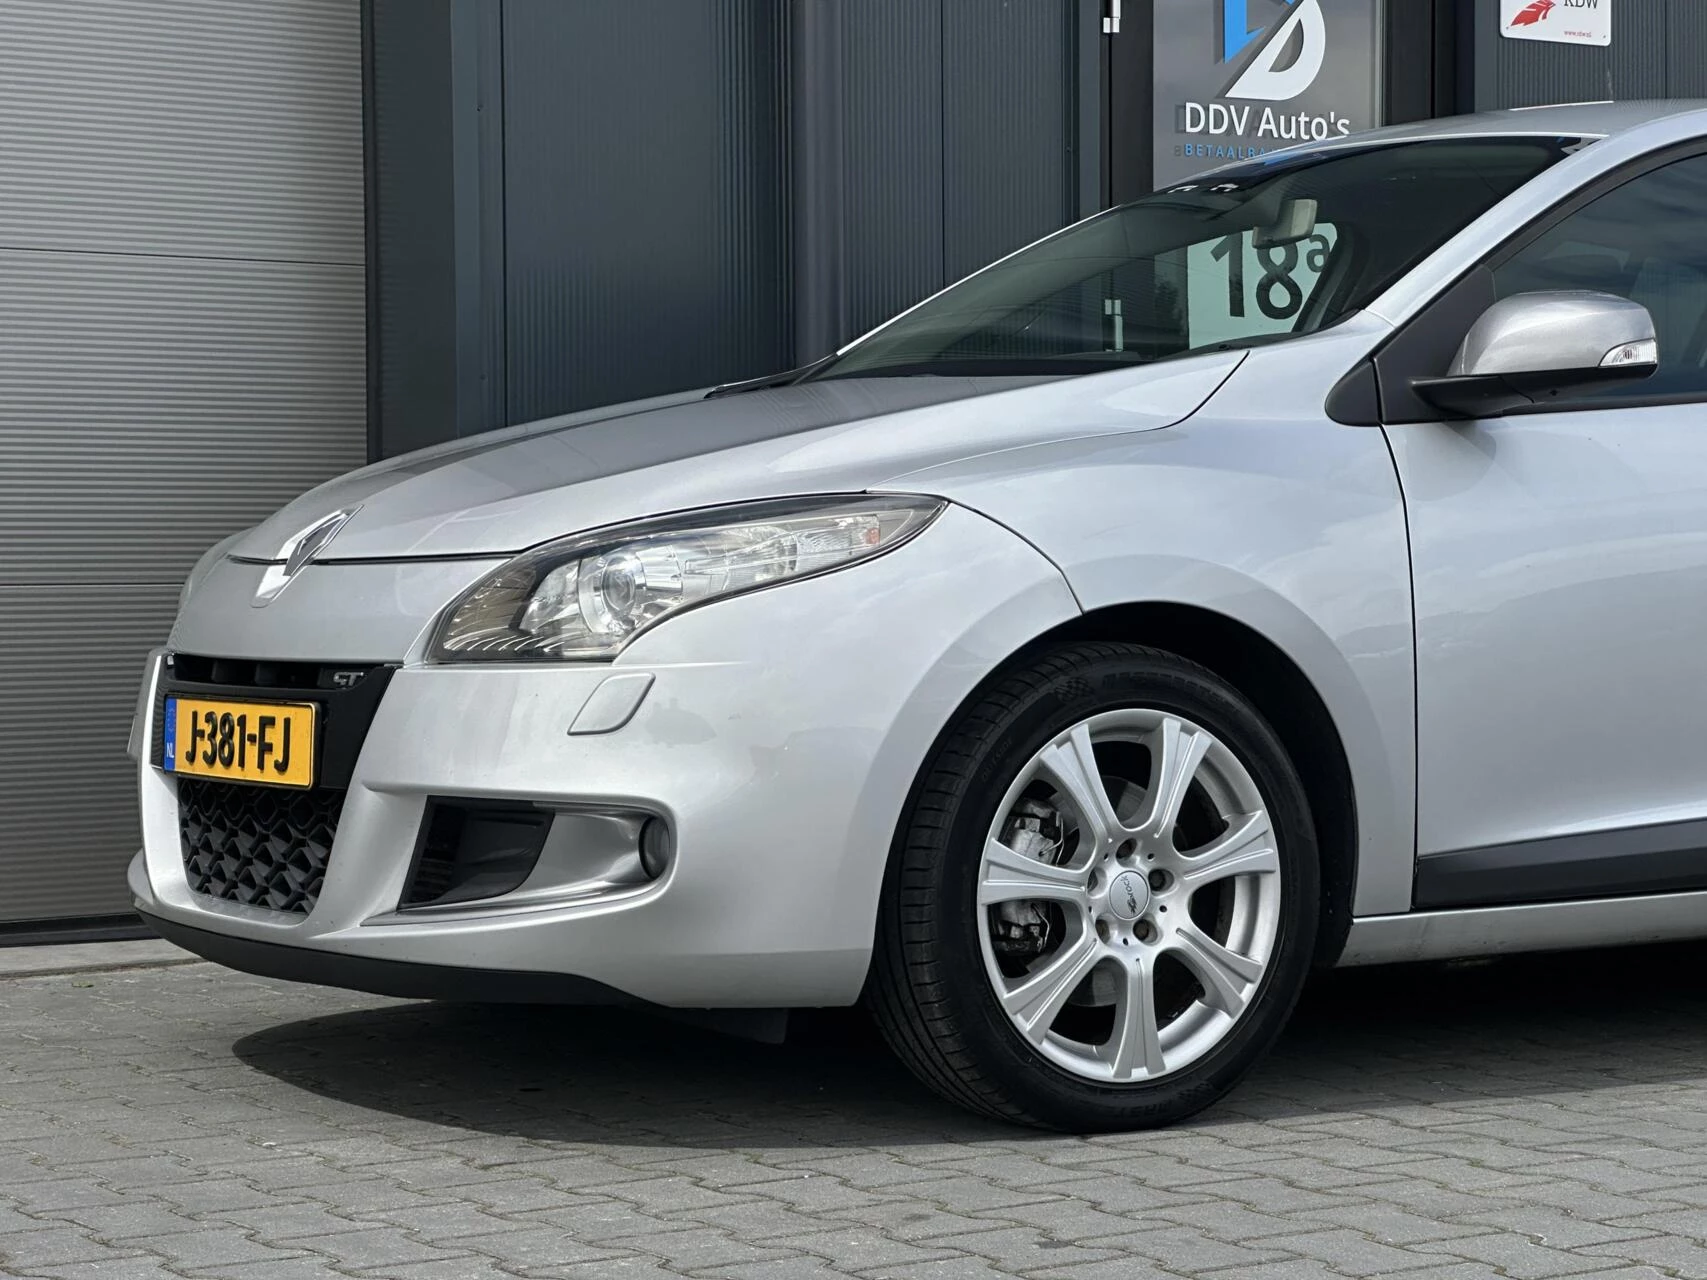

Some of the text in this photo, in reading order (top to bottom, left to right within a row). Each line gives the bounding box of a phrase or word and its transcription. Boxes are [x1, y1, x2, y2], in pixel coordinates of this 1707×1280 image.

[1185, 101, 1350, 141] DDV Auto's
[1184, 144, 1274, 160] BETAALBA
[333, 671, 364, 686] GT
[166, 742, 175, 759] NL
[185, 710, 292, 776] J-381-FJ
